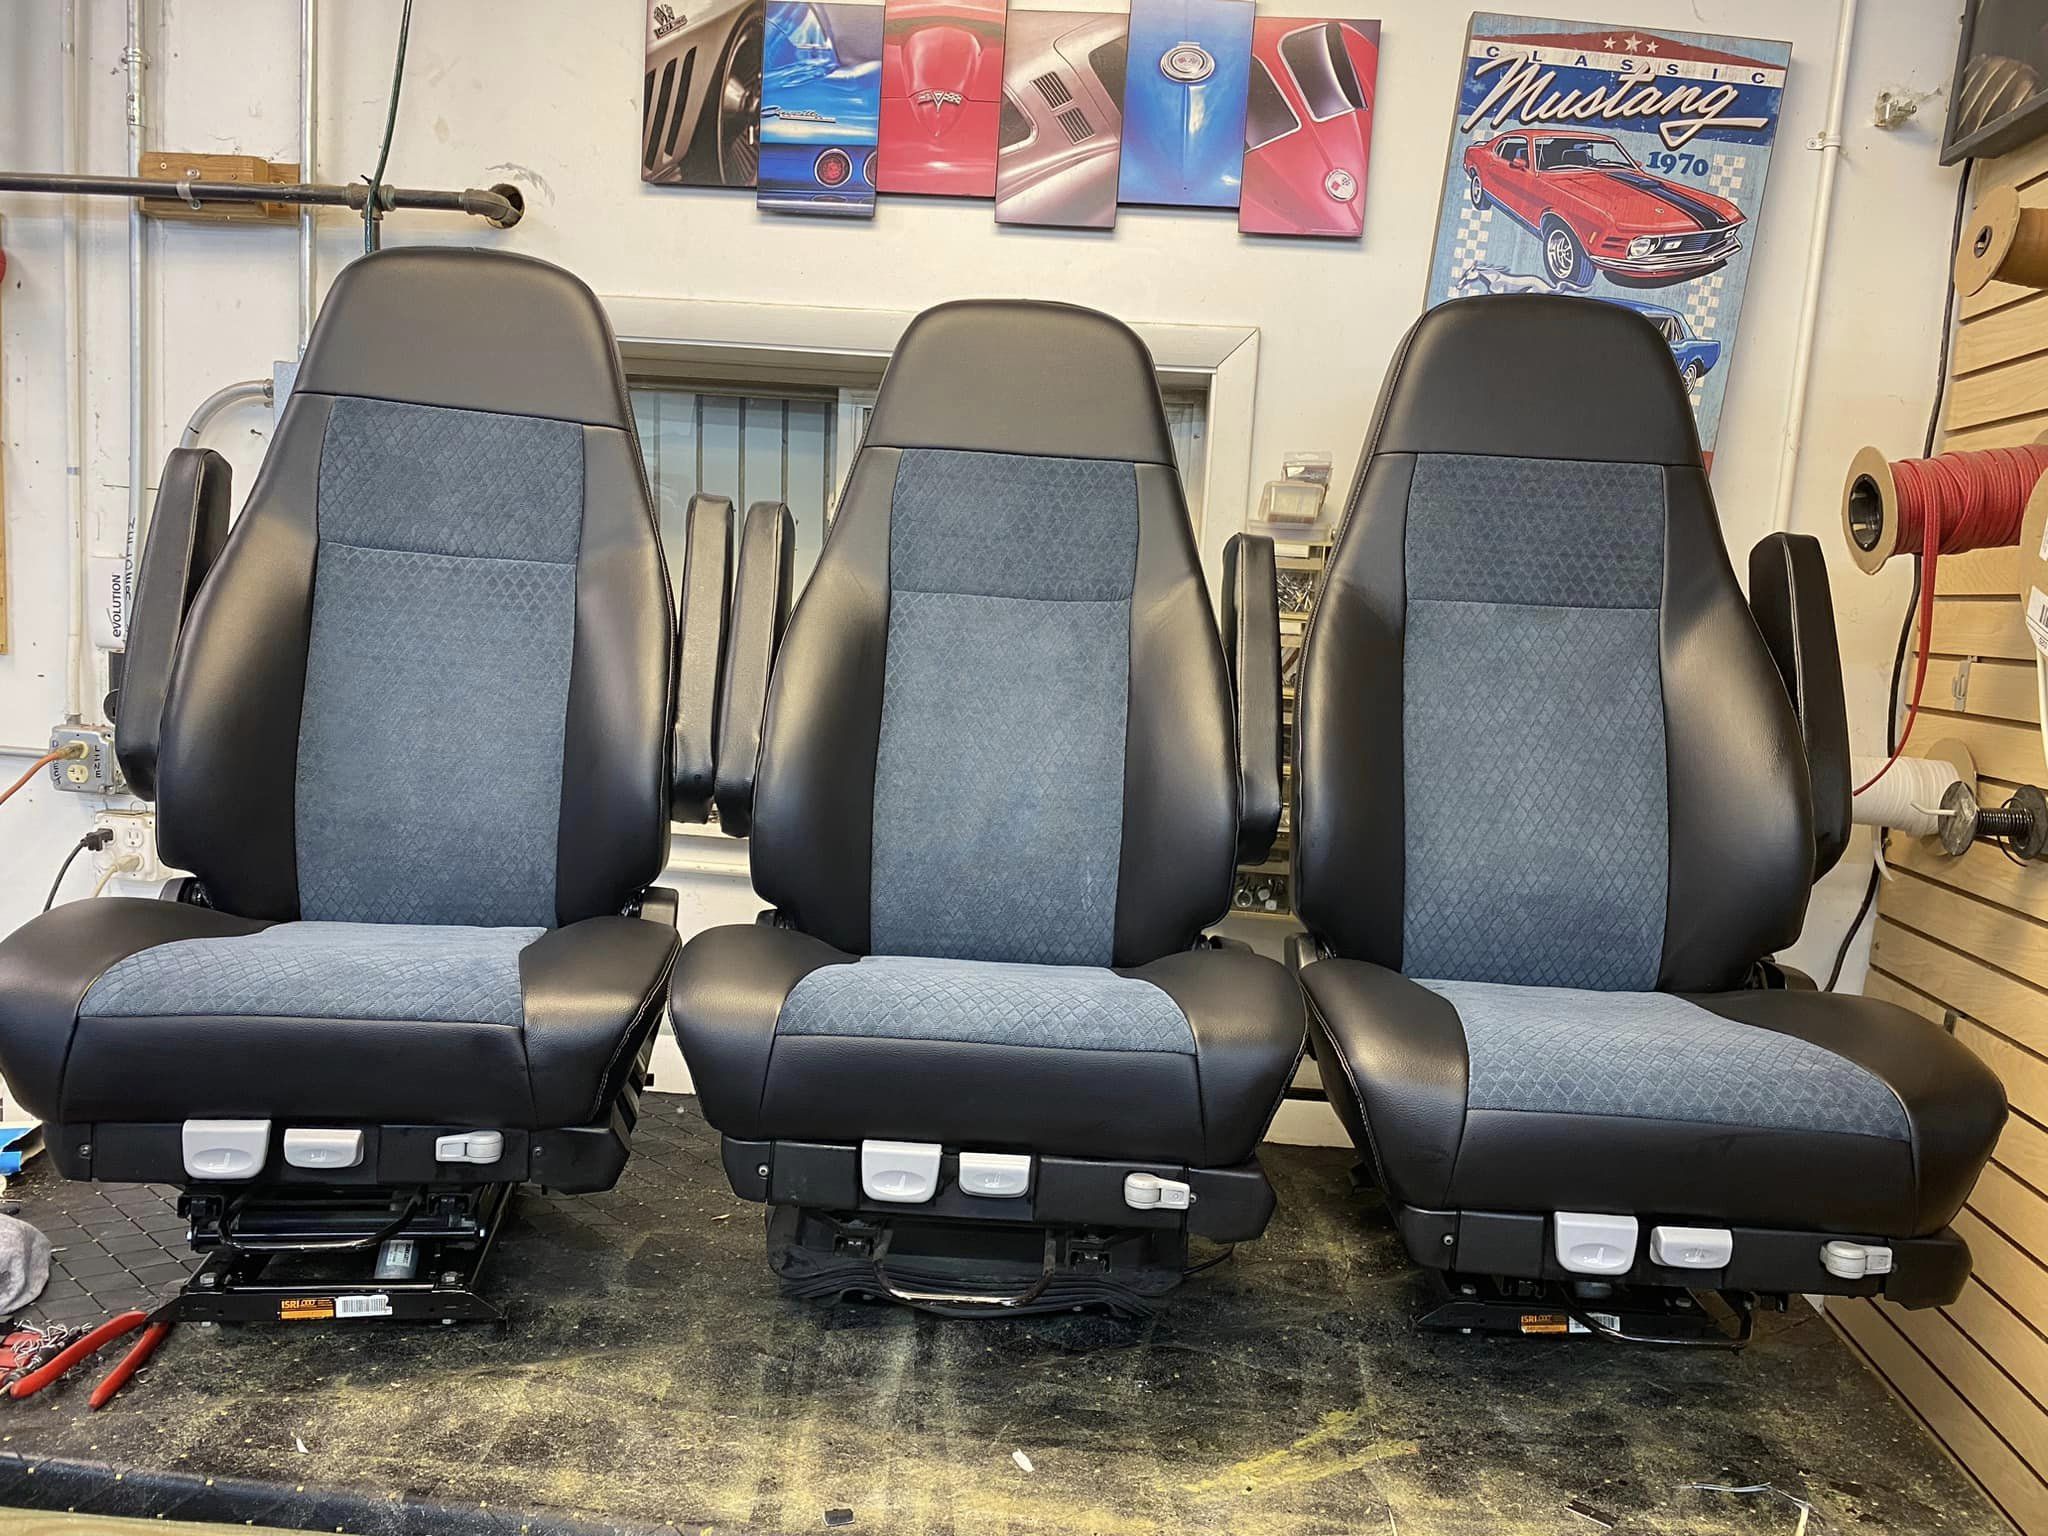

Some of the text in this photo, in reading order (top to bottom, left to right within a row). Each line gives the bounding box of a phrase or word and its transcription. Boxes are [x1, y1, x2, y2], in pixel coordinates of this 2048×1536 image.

[1486, 46, 1767, 84] CLASSIC
[1461, 52, 1769, 152] Mustang
[1646, 150, 1710, 177] 1970
[52, 740, 62, 785] DECT
[281, 1300, 300, 1309] ISRI
